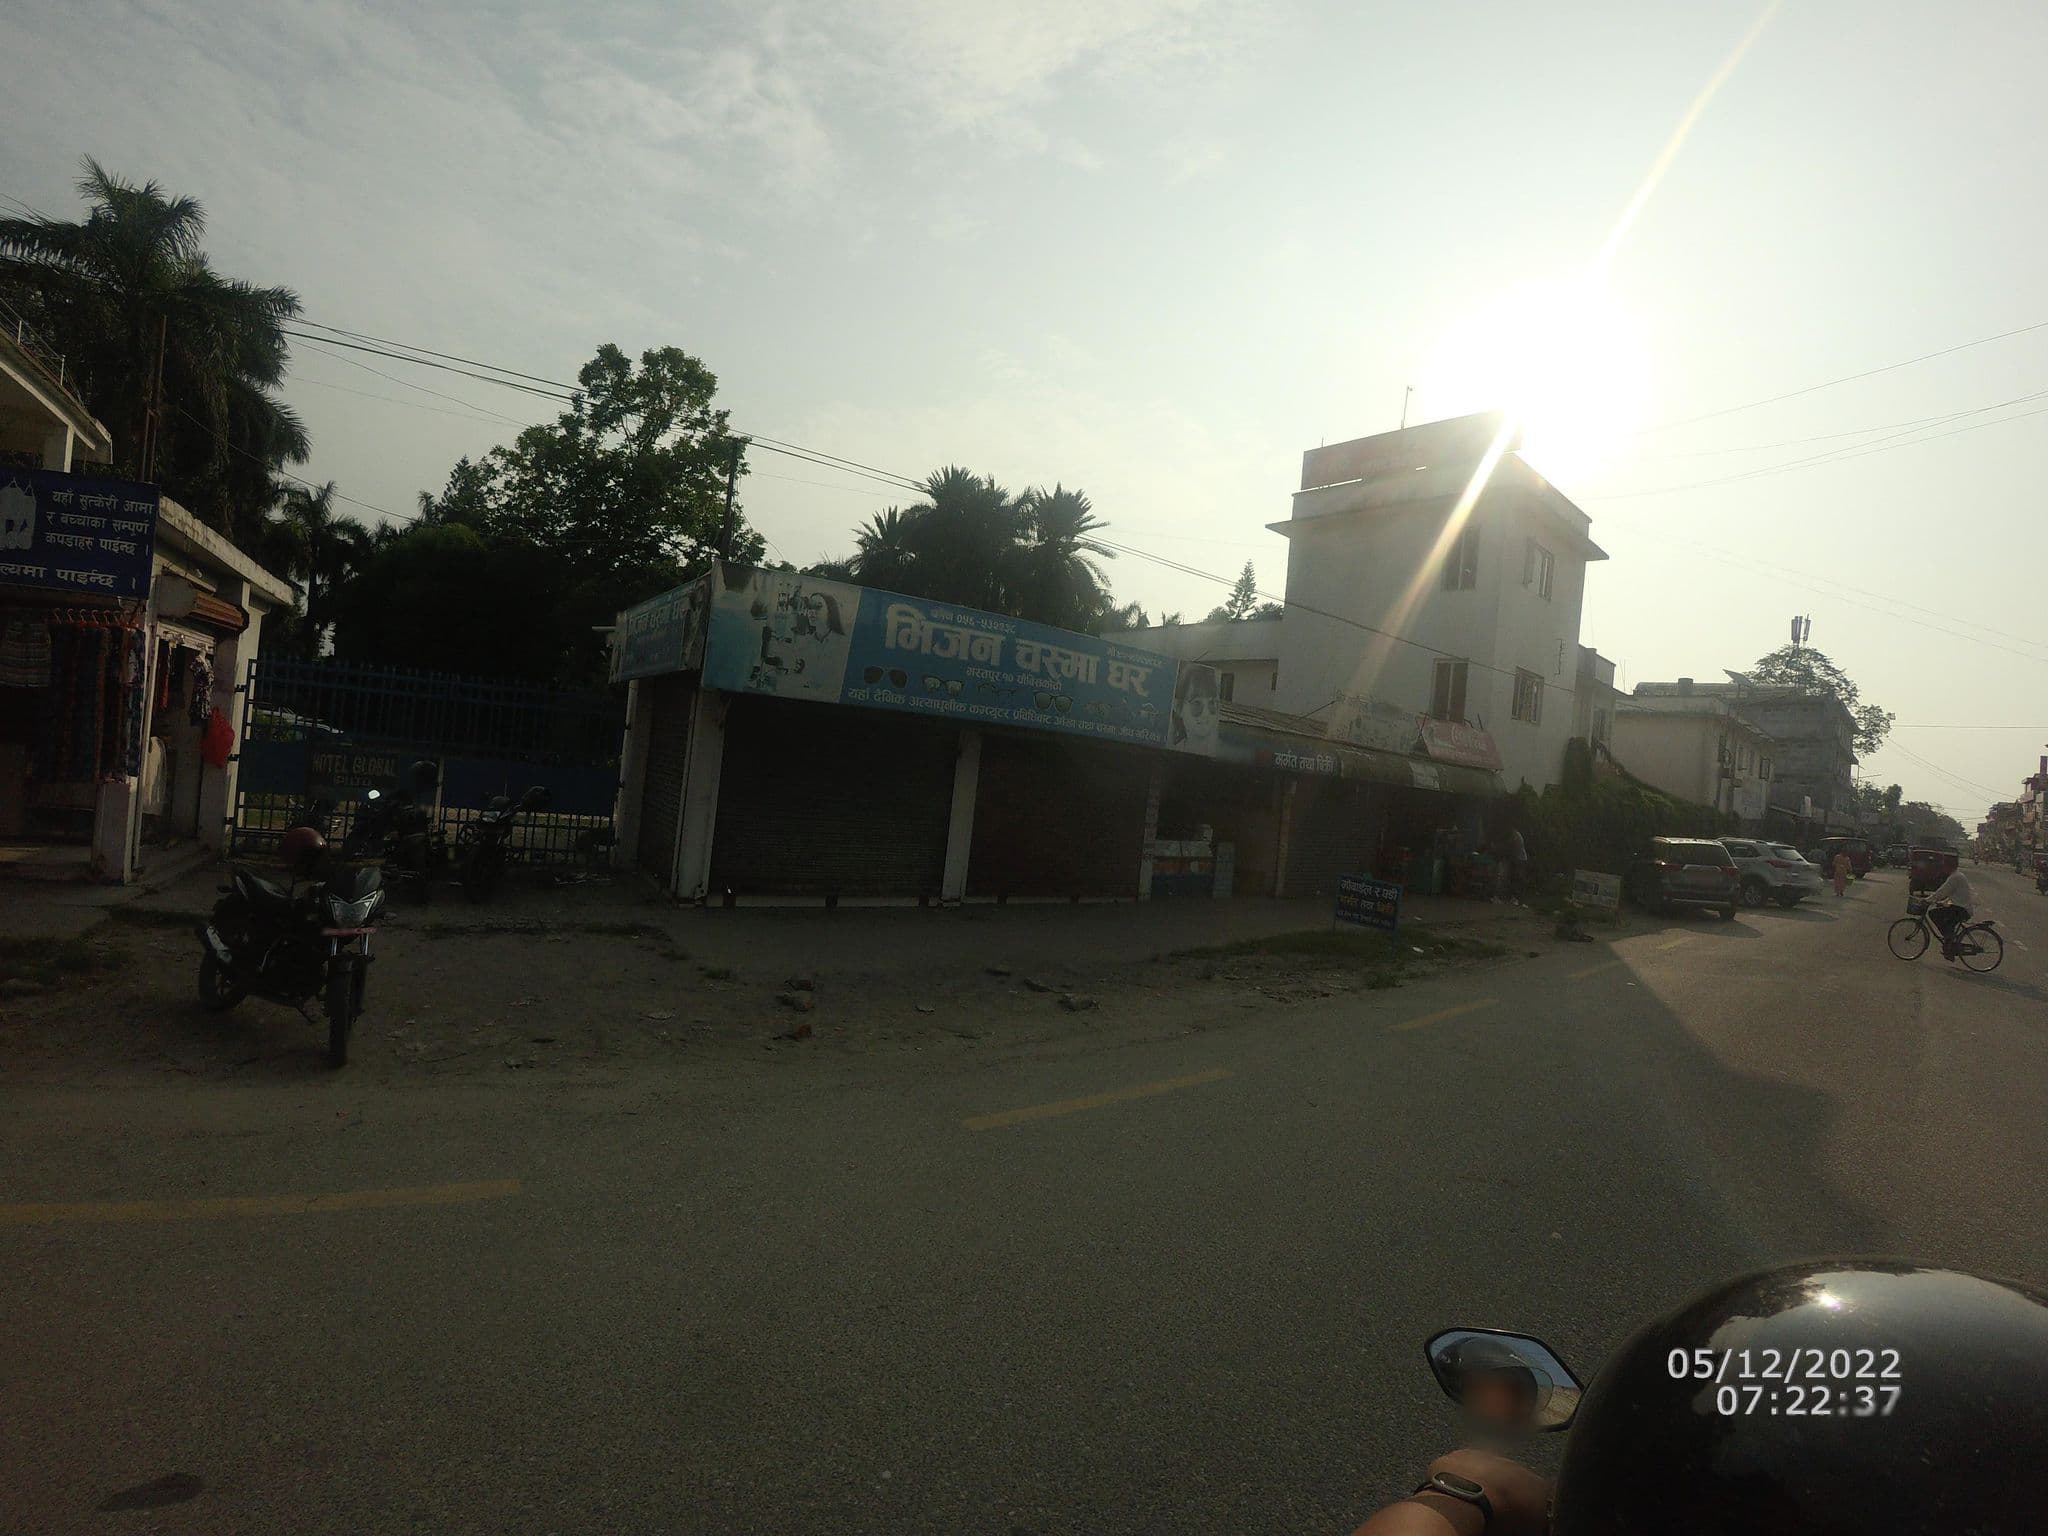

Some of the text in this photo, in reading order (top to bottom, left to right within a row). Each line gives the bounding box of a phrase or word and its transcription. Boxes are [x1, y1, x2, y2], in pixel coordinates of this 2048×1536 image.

[52, 488, 155, 514] यहाँ सुत्केरी आमा
[46, 511, 56, 525] र
[1107, 659, 1153, 698] घर
